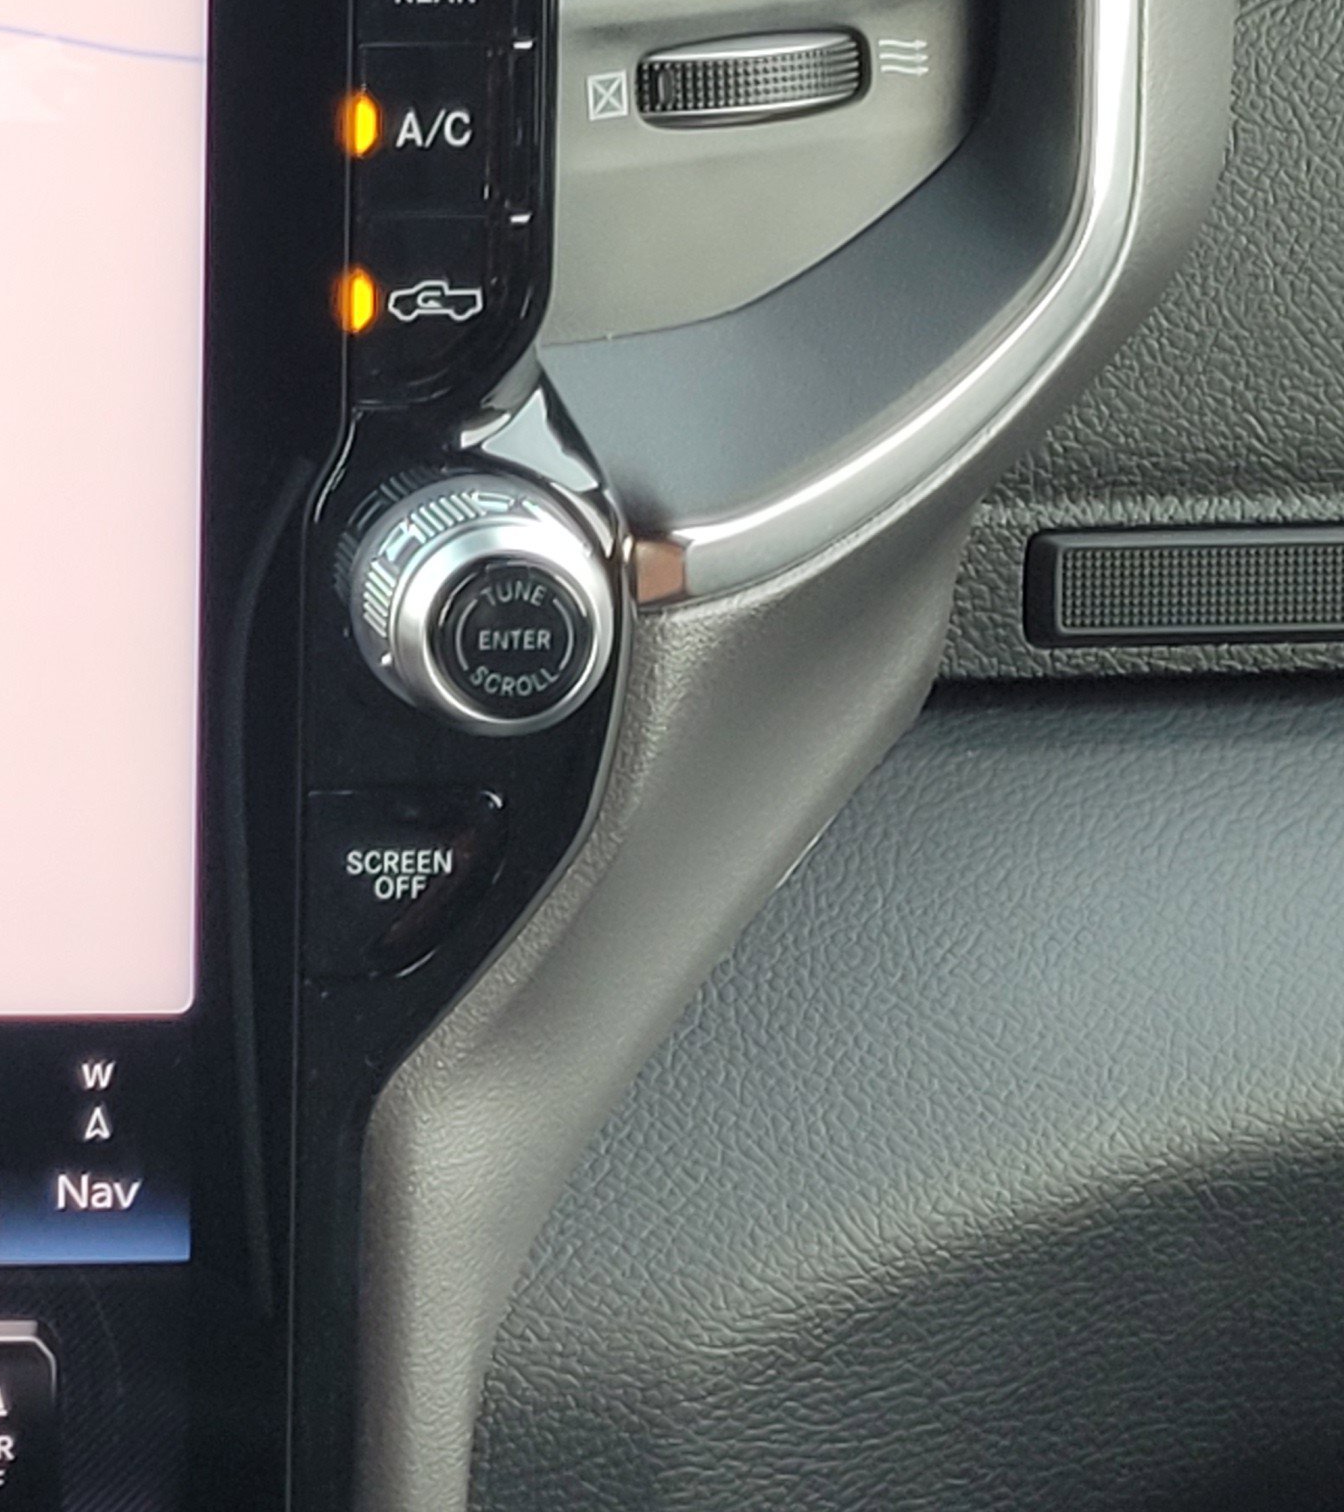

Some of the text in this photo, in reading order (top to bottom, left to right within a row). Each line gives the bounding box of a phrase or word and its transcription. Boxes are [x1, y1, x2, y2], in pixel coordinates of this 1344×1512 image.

[395, 108, 473, 148] A/C
[480, 581, 549, 608] TUNE
[478, 629, 552, 651] ENTER
[470, 665, 560, 697] SCROLL
[346, 849, 453, 875] SCREEN
[374, 875, 426, 900] OFF
[81, 1061, 115, 1089] W
[56, 1173, 142, 1210] Nav
